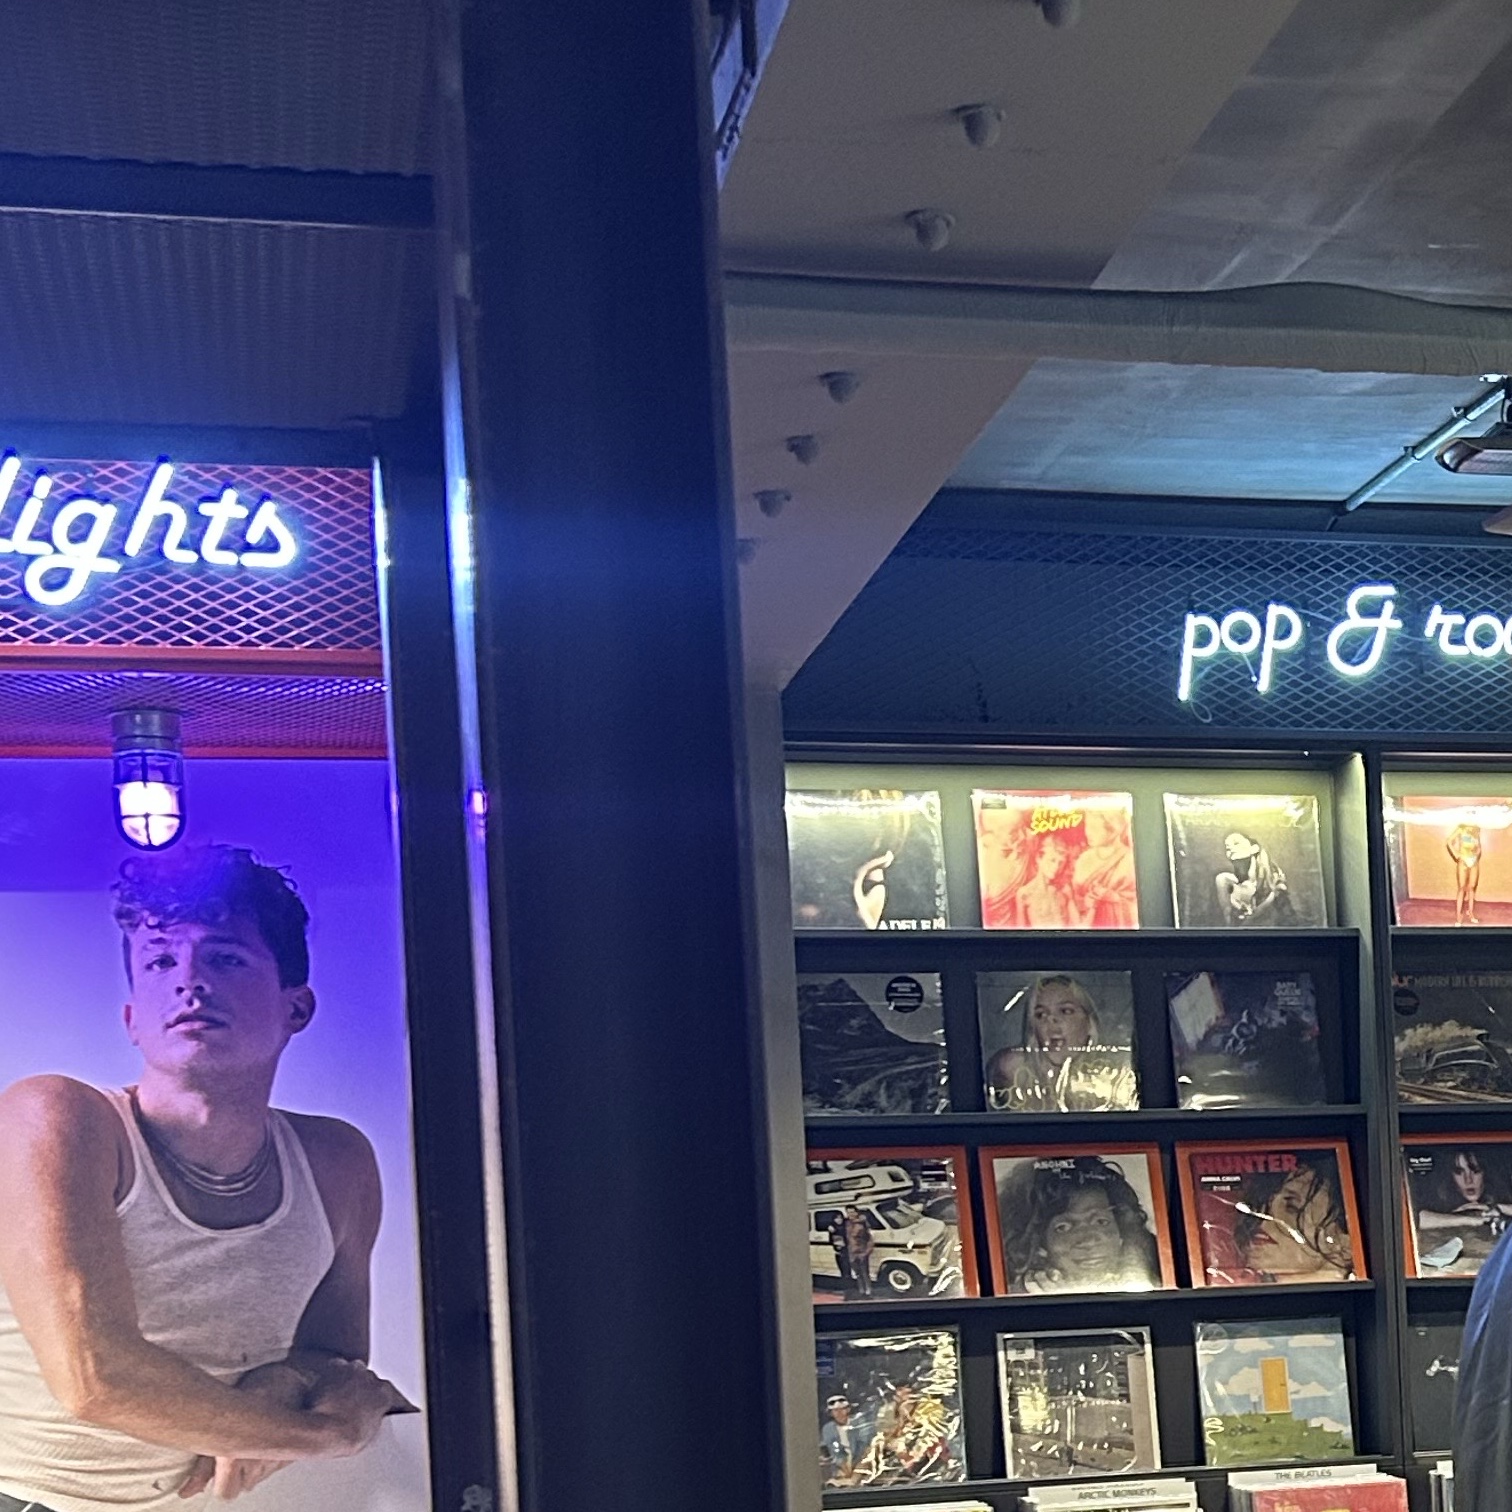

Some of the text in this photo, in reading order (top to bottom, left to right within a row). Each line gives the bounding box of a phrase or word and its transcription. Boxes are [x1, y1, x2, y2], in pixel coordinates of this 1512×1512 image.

[1178, 610, 1303, 701] pop
[1325, 582, 1402, 677] &
[1193, 1153, 1298, 1174] HUNTER
[1274, 1469, 1332, 1480] THE BEATLES
[1078, 1490, 1111, 1500] ARCTIC
[1111, 1487, 1158, 1498] MONKEYS
